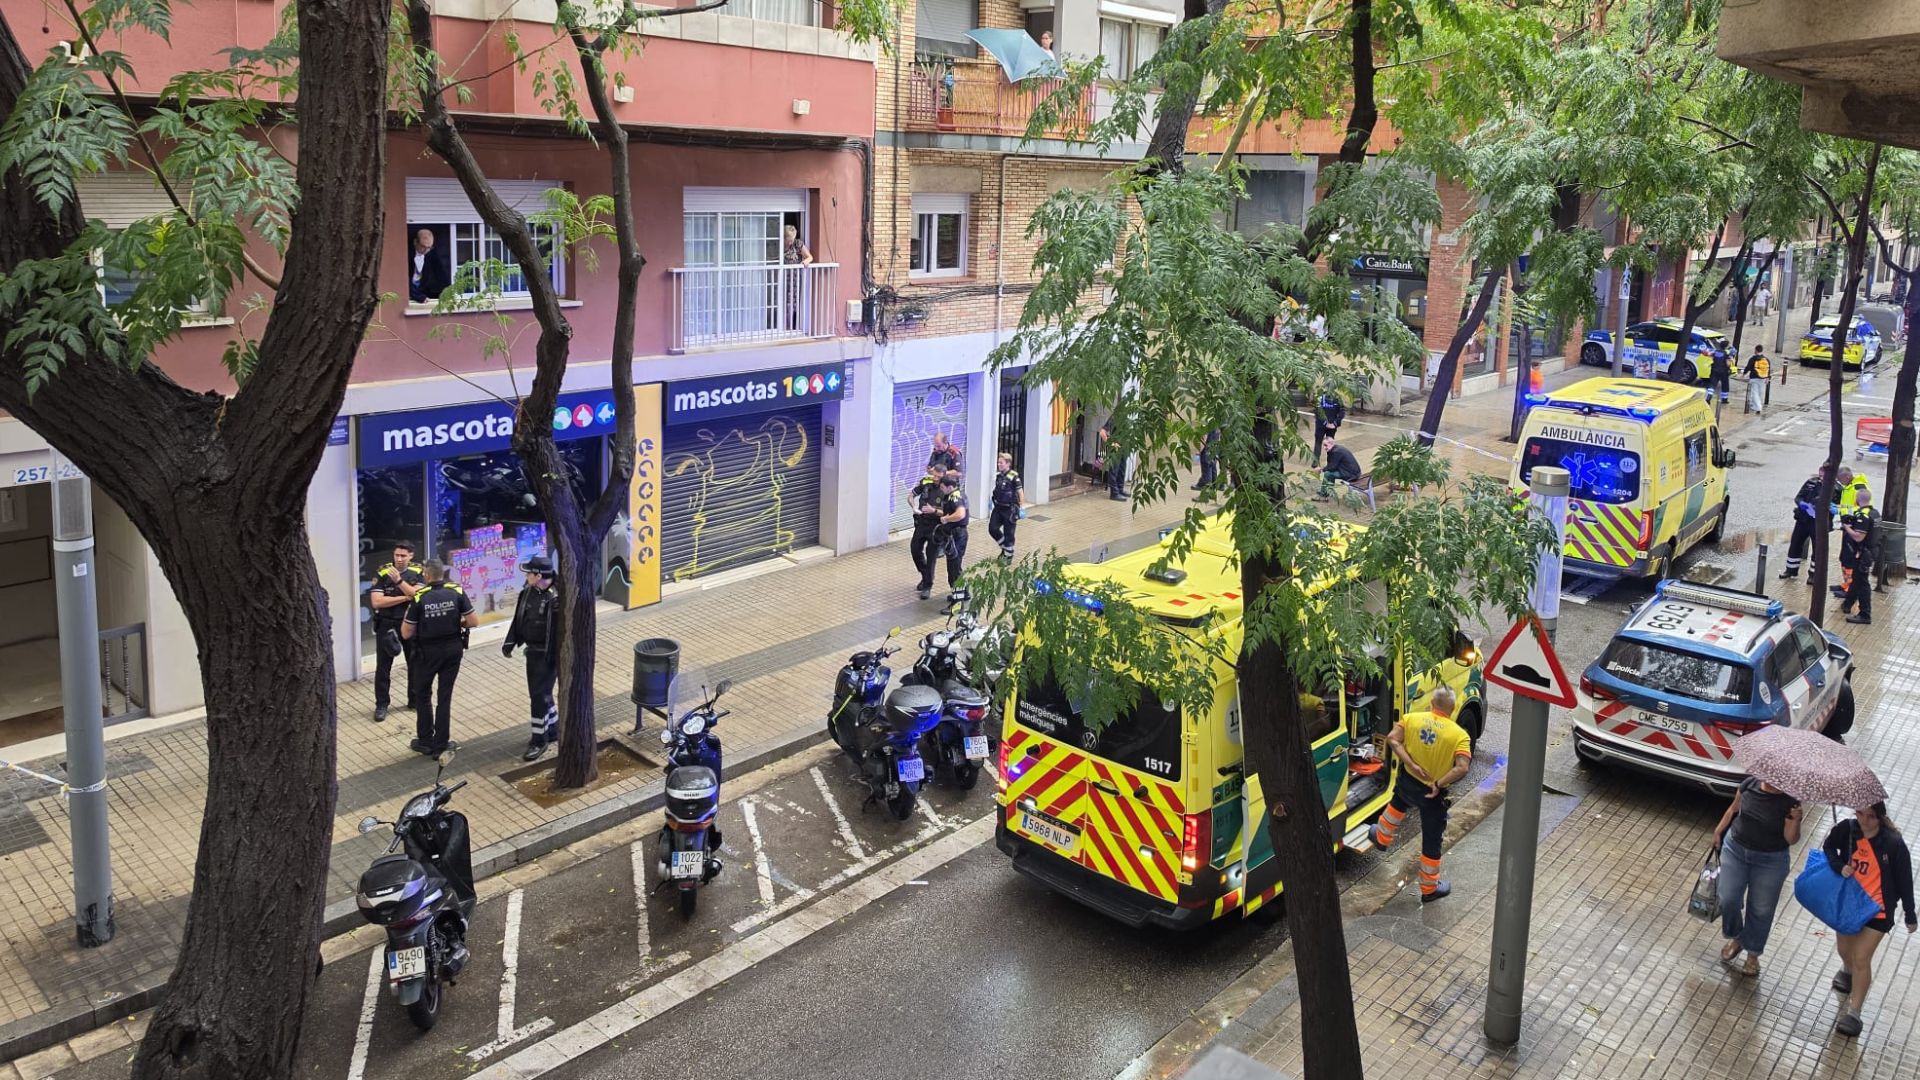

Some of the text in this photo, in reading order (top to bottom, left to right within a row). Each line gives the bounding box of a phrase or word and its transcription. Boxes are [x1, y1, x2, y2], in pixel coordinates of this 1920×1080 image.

[1366, 256, 1413, 271] CaixaBank
[674, 381, 778, 412] mascotas
[383, 413, 518, 451] mascota
[1540, 425, 1626, 449] AMBULÀNCIA
[17, 467, 48, 482] 257
[424, 600, 455, 610] POLICIA
[1646, 604, 1695, 630] 5759
[1019, 710, 1055, 732] mèdiques
[1020, 700, 1068, 726] emergències
[1661, 716, 1688, 732] 5759
[1144, 756, 1172, 775] 1517
[1028, 818, 1071, 847] 5968 NLP
[681, 852, 702, 863] 1022
[678, 864, 694, 874] CNF
[397, 948, 423, 963] 9490
[398, 962, 417, 975] JFY
